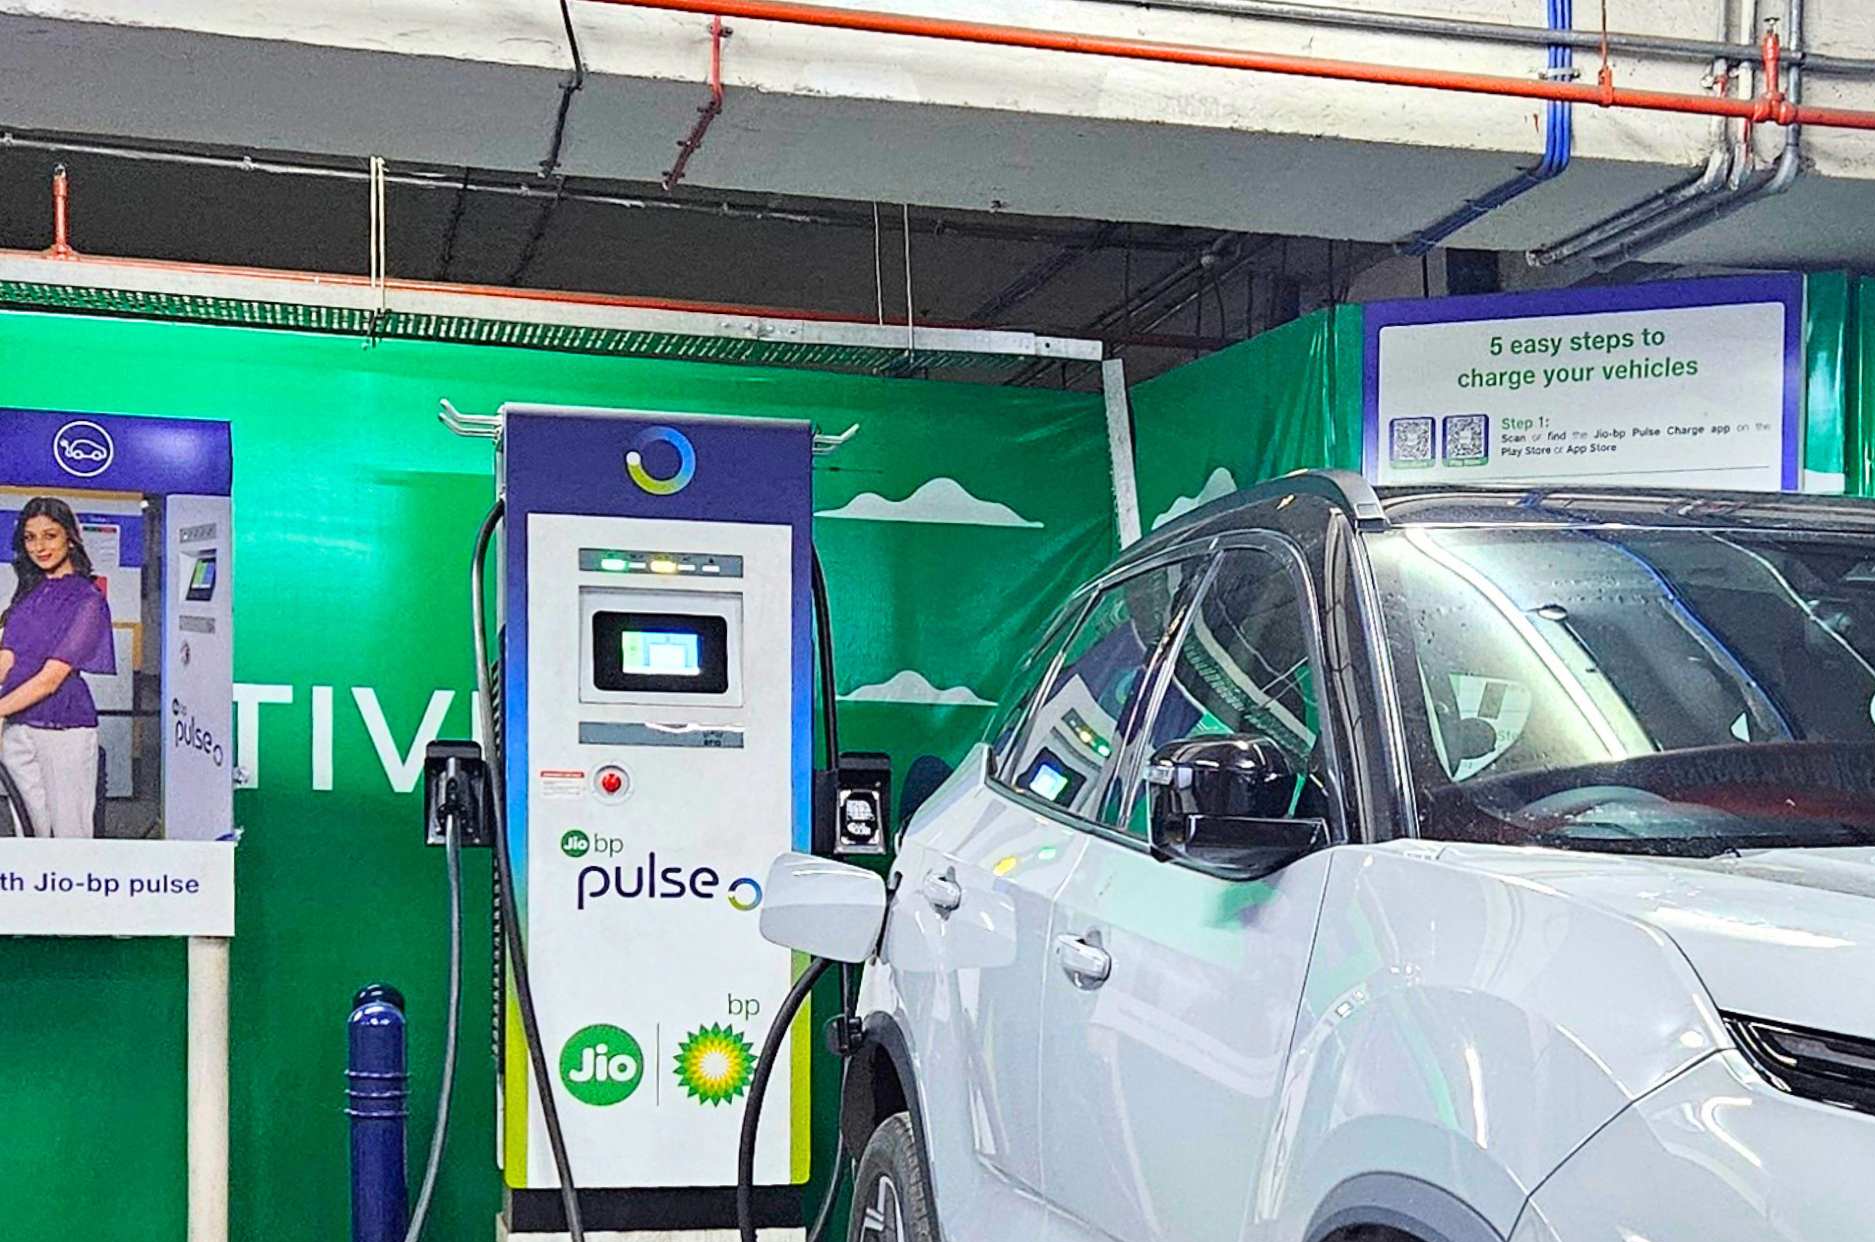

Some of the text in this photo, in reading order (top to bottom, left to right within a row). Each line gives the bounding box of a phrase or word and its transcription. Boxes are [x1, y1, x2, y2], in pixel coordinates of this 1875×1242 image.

[1489, 327, 1665, 357] 5 easy steps to
[1457, 356, 1698, 391] charge your vehicles
[1501, 416, 1550, 431] Step 1:
[1501, 433, 1526, 443] Scan
[1547, 430, 1567, 441] find
[1594, 427, 1626, 440] Jio-bp
[1632, 425, 1661, 437] Pulse
[1667, 425, 1705, 436] Charge
[1711, 424, 1731, 434] app
[1501, 447, 1522, 457] Play
[1525, 446, 1551, 455] Store
[1567, 444, 1588, 454] App
[1590, 442, 1617, 453] Store
[563, 832, 623, 858] Jio bp
[34, 872, 120, 897] Jio-bp
[129, 874, 200, 897] pulse
[577, 851, 720, 910] pulse
[727, 993, 761, 1021] bp
[568, 1043, 638, 1083] Jio
